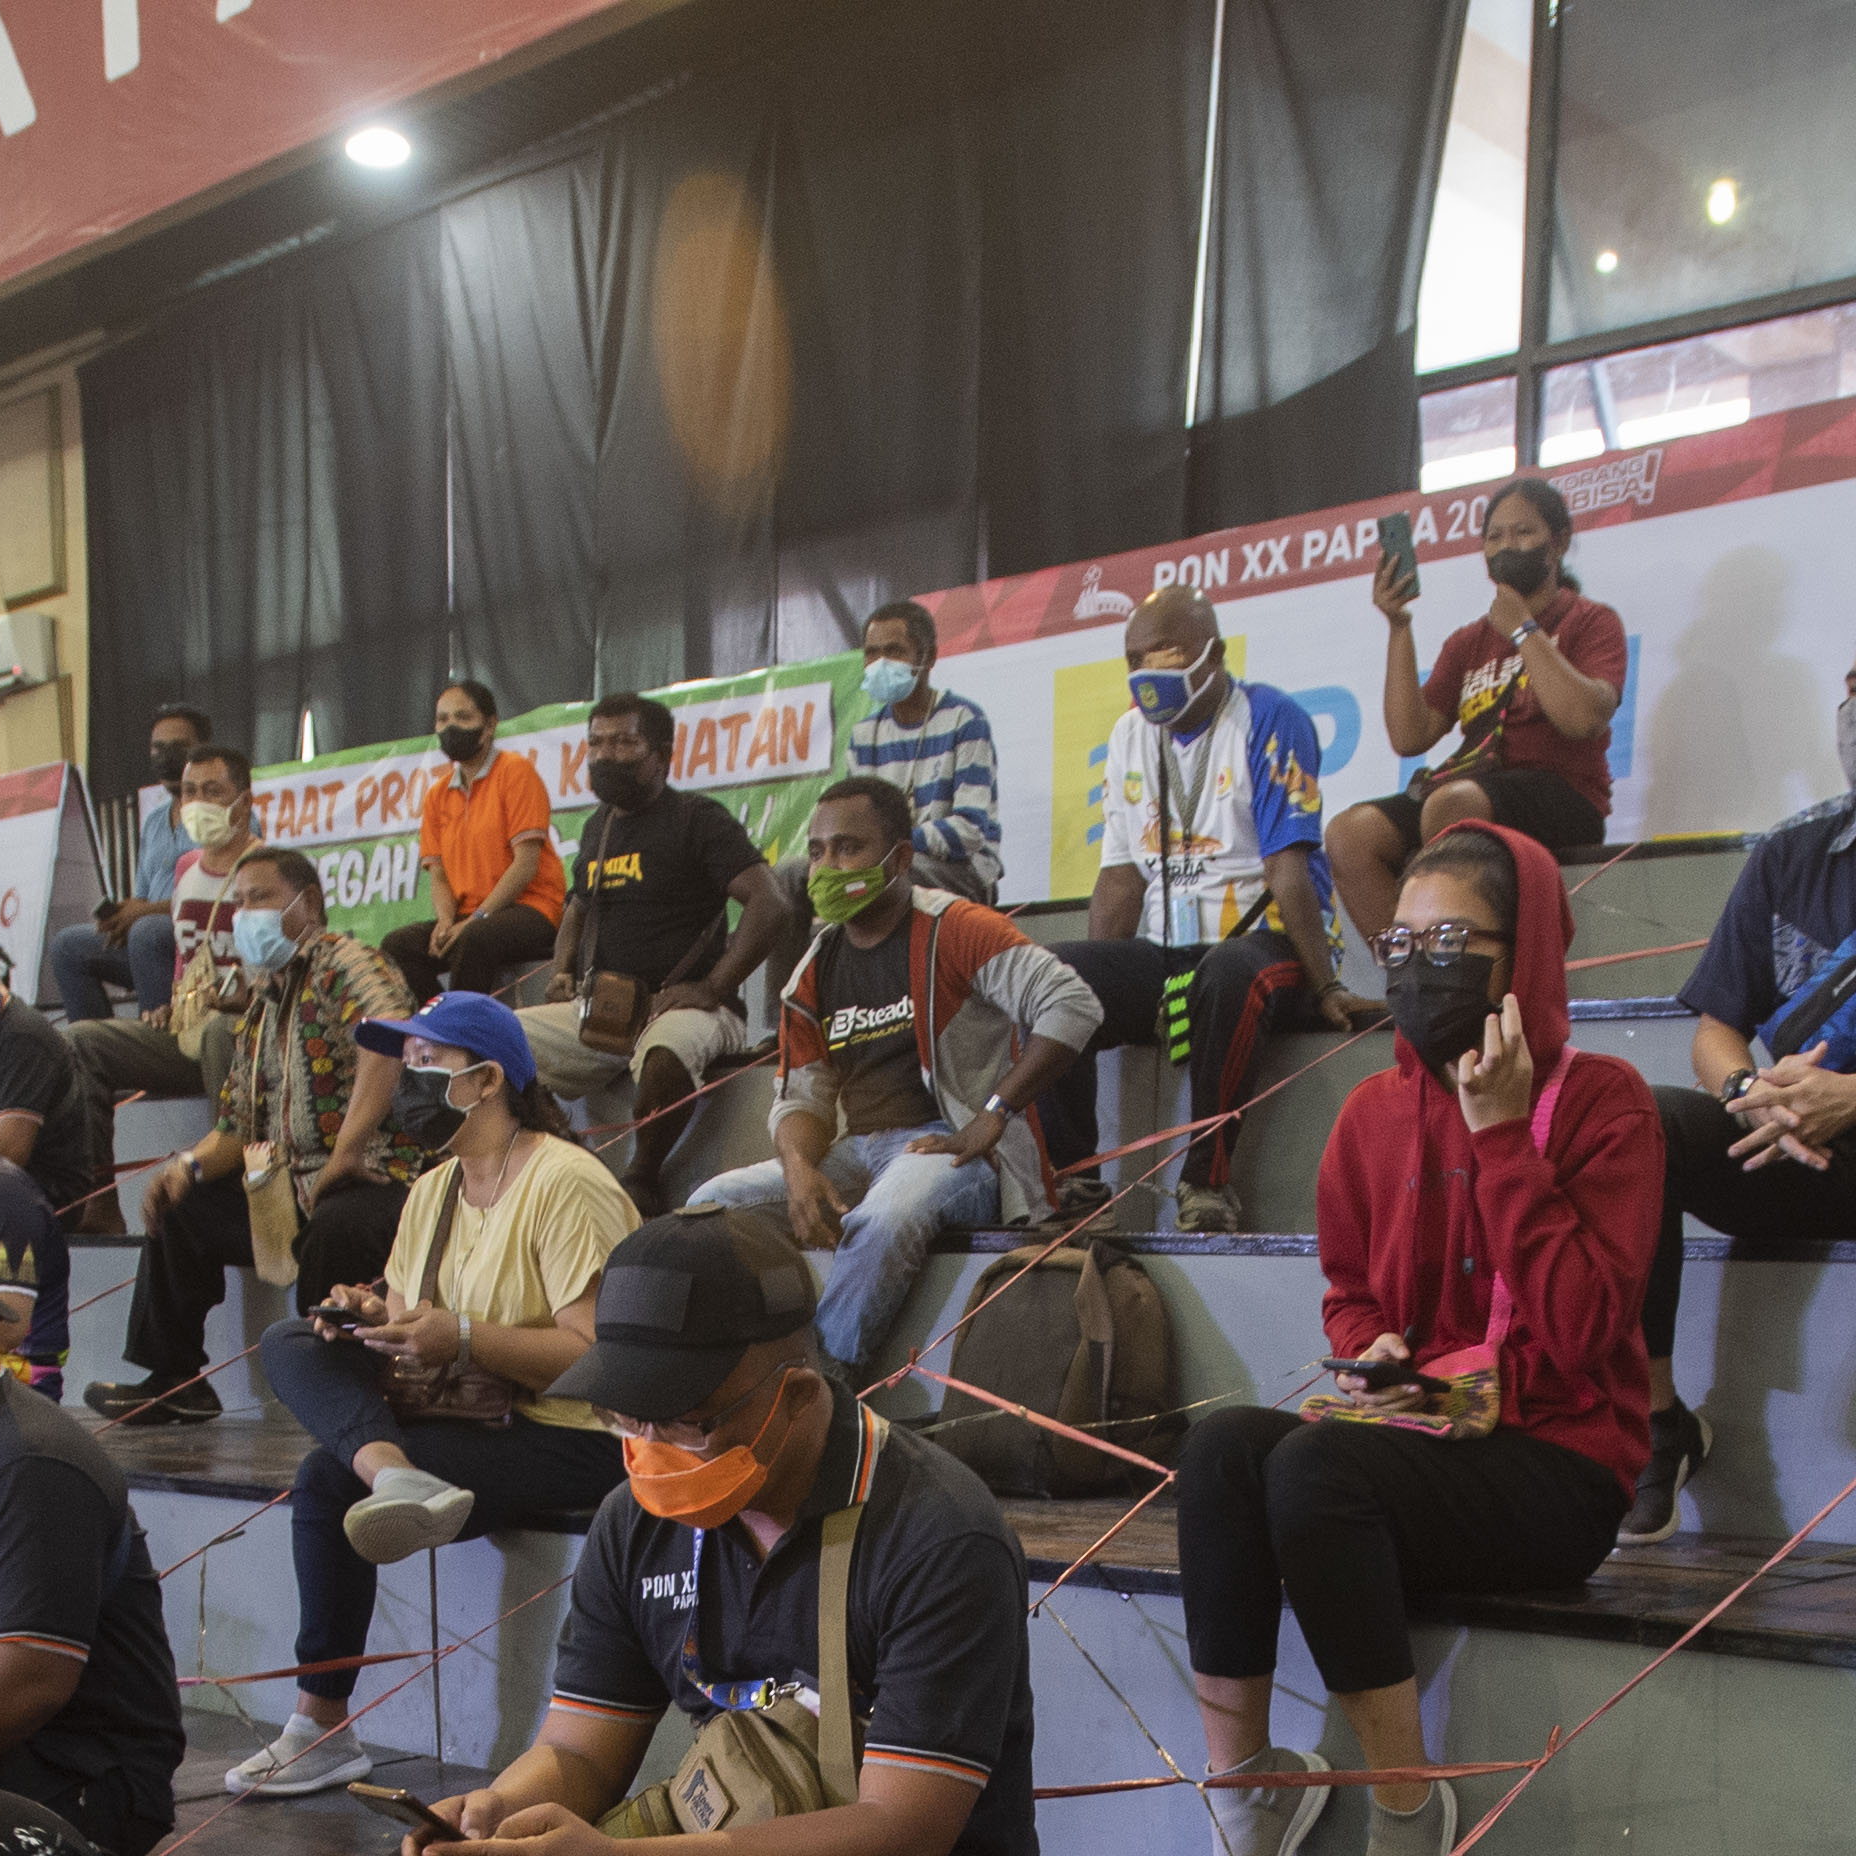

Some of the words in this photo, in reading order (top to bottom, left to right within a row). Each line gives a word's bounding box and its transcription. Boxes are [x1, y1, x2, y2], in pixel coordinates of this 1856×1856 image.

[1240, 535, 1291, 583] XX
[1301, 505, 1440, 571] PAPA
[251, 778, 346, 842] TAAT
[312, 840, 423, 909] EGAH
[641, 1572, 676, 1600] PON
